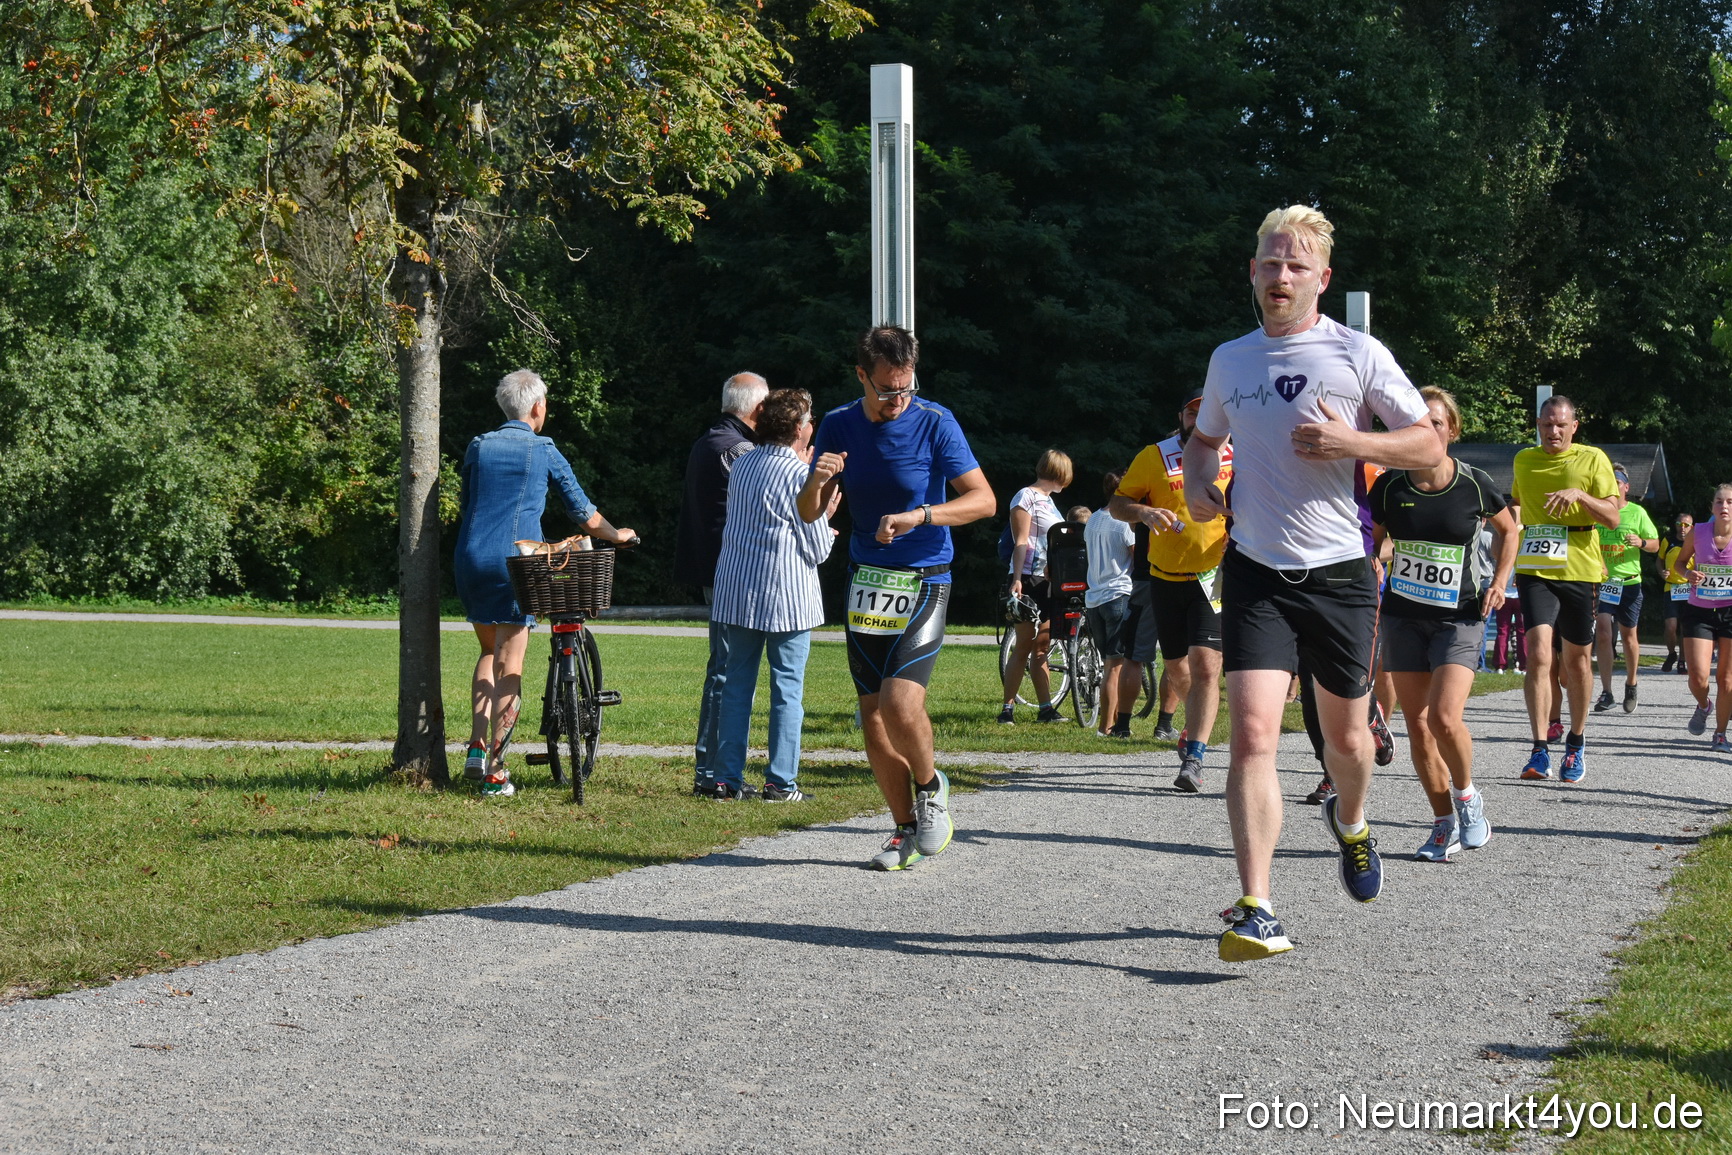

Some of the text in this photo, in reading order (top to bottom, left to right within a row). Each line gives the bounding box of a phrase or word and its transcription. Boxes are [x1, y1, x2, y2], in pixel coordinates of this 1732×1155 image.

[1284, 380, 1300, 394] IT
[1527, 527, 1562, 537] BOCK
[1400, 542, 1456, 562] BOCK
[1526, 540, 1561, 554] 1397
[857, 568, 914, 589] BOCK
[1400, 558, 1453, 585] 2180
[1396, 581, 1452, 600] CHRISTINE
[1600, 584, 1619, 594] 088
[856, 589, 909, 614] 1170
[852, 615, 898, 627] MICHAEL
